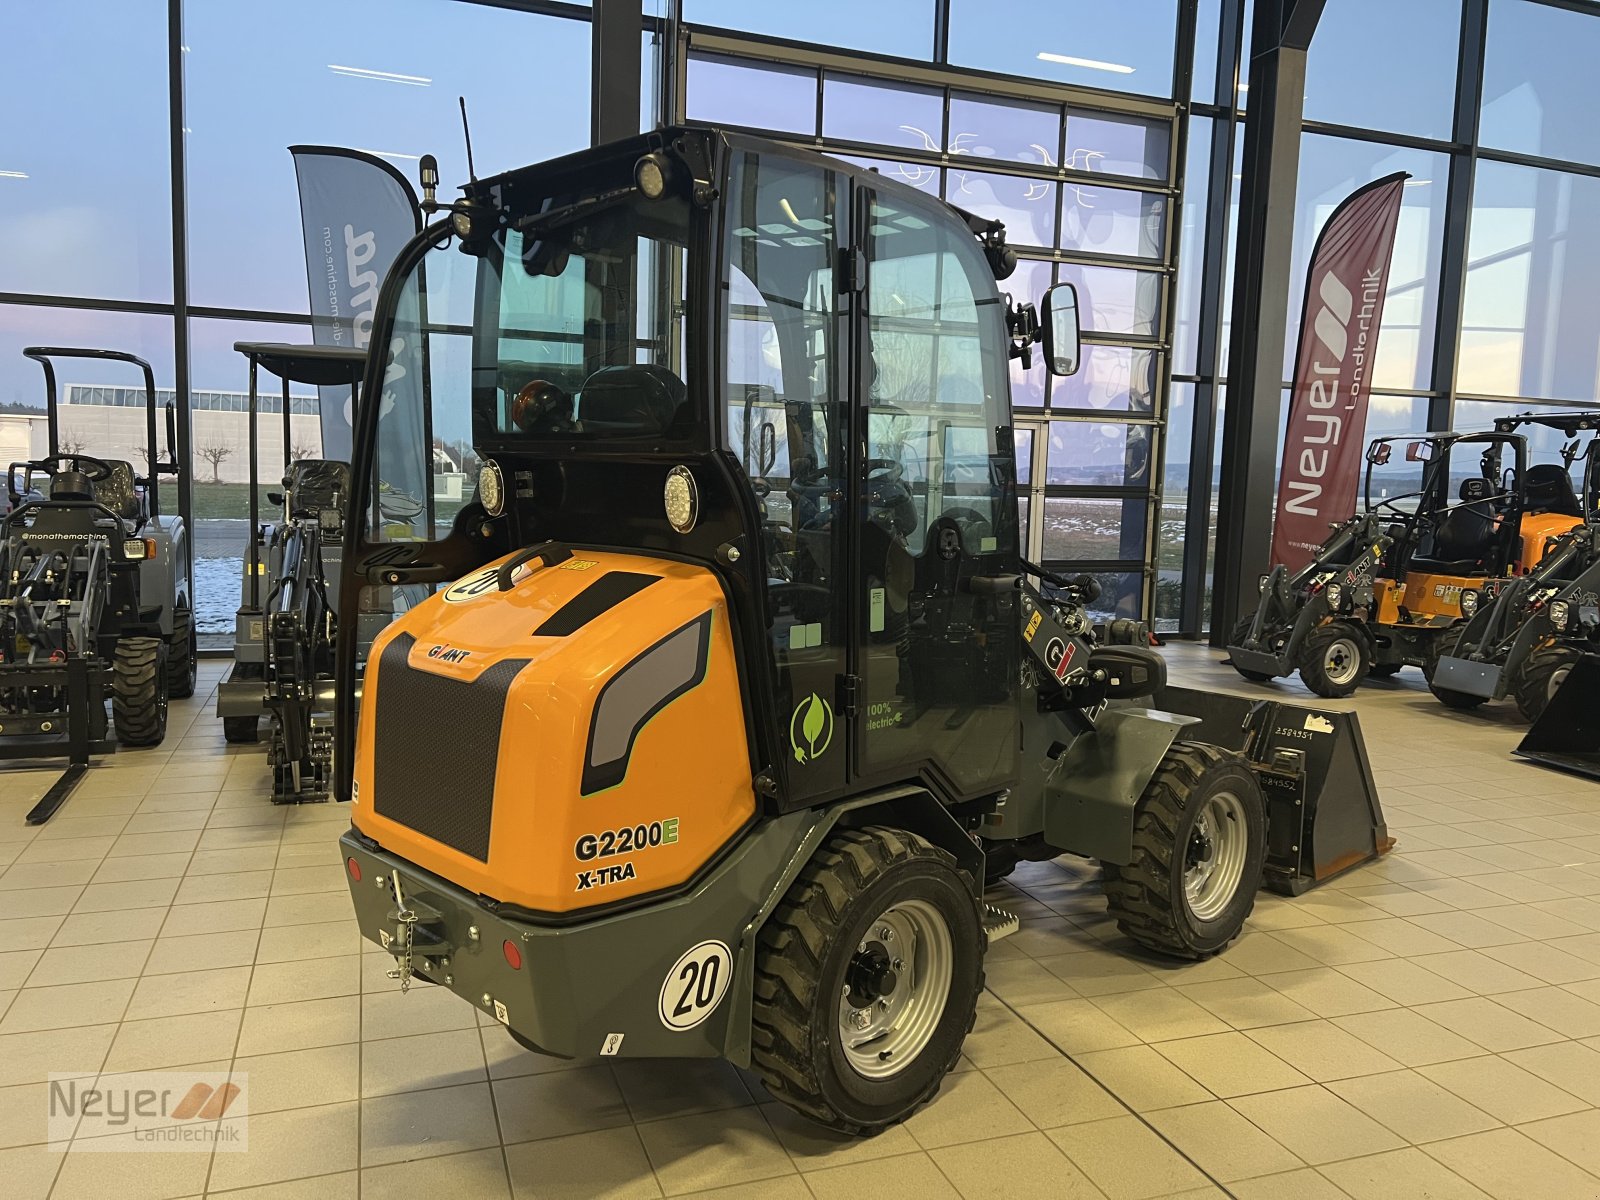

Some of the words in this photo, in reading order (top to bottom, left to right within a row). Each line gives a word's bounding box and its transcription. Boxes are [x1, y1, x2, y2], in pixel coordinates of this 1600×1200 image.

[1285, 361, 1342, 517] Neyer
[427, 643, 471, 664] GIANT
[866, 702, 892, 716] 100%
[1261, 776, 1297, 791] 584952
[575, 817, 680, 862] G2200E
[575, 862, 637, 892] X-TRA
[672, 955, 721, 1019] 20
